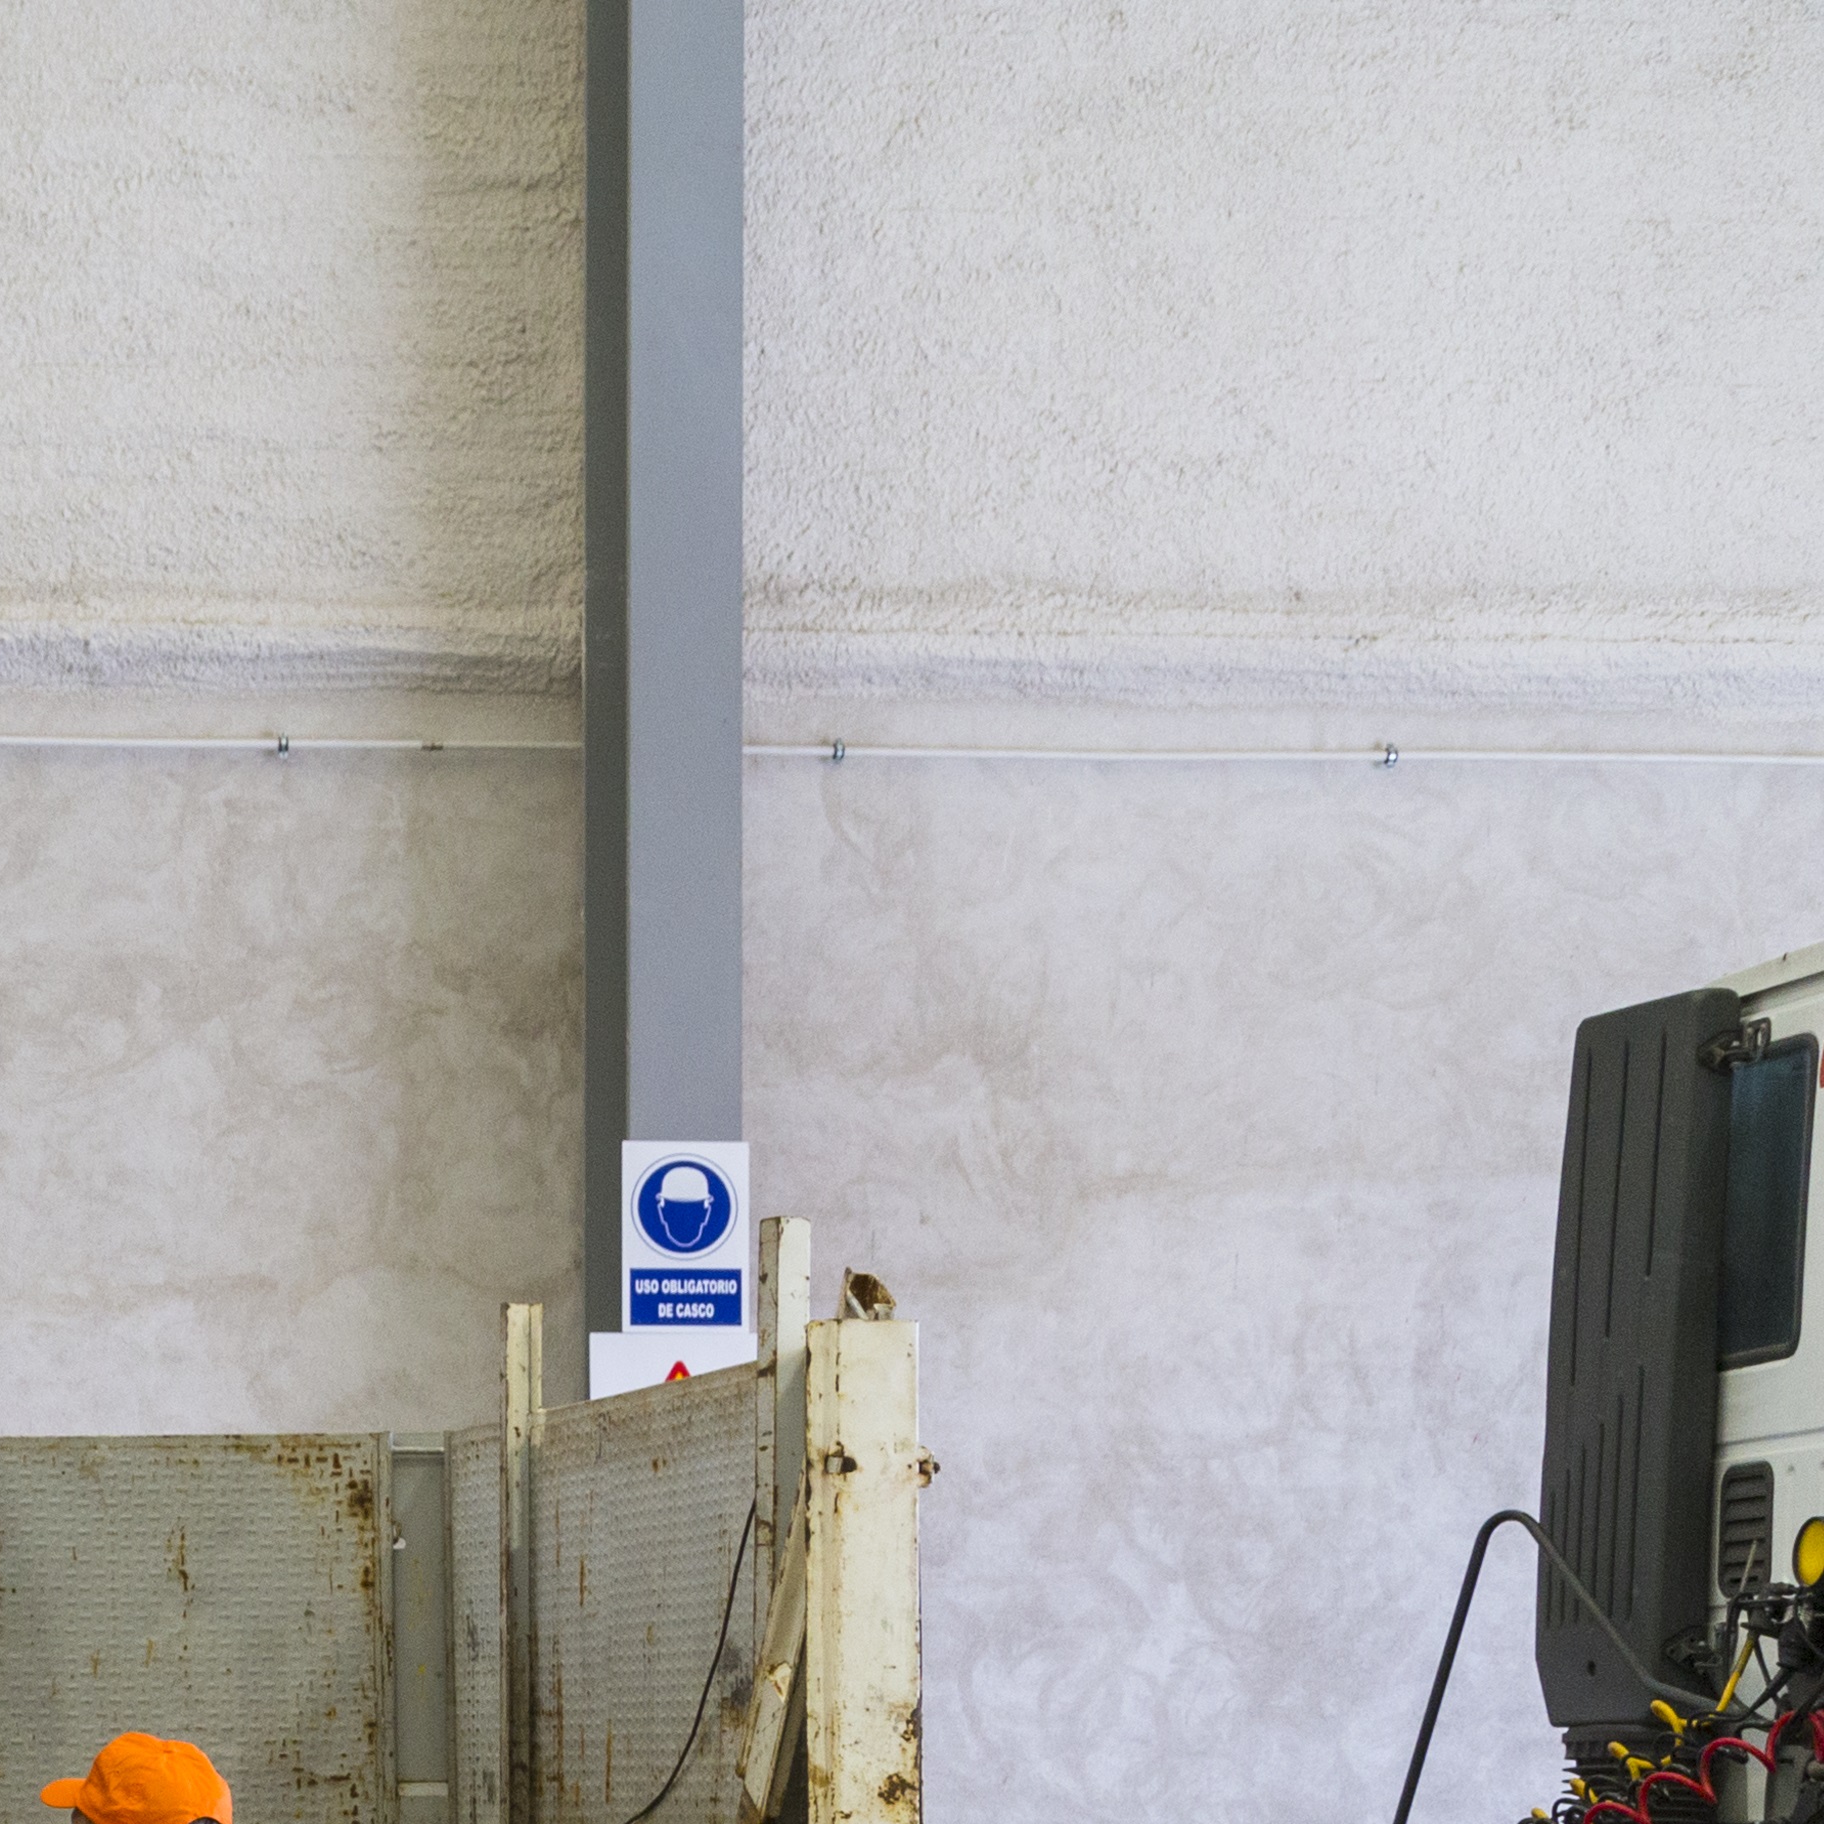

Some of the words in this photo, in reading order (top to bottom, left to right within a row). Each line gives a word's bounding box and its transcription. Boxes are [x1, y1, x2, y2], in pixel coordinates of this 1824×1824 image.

[635, 1279, 659, 1294] USO
[661, 1279, 738, 1294] OBLIGATORIO
[658, 1303, 673, 1318] DE
[675, 1303, 715, 1318] CASCO
